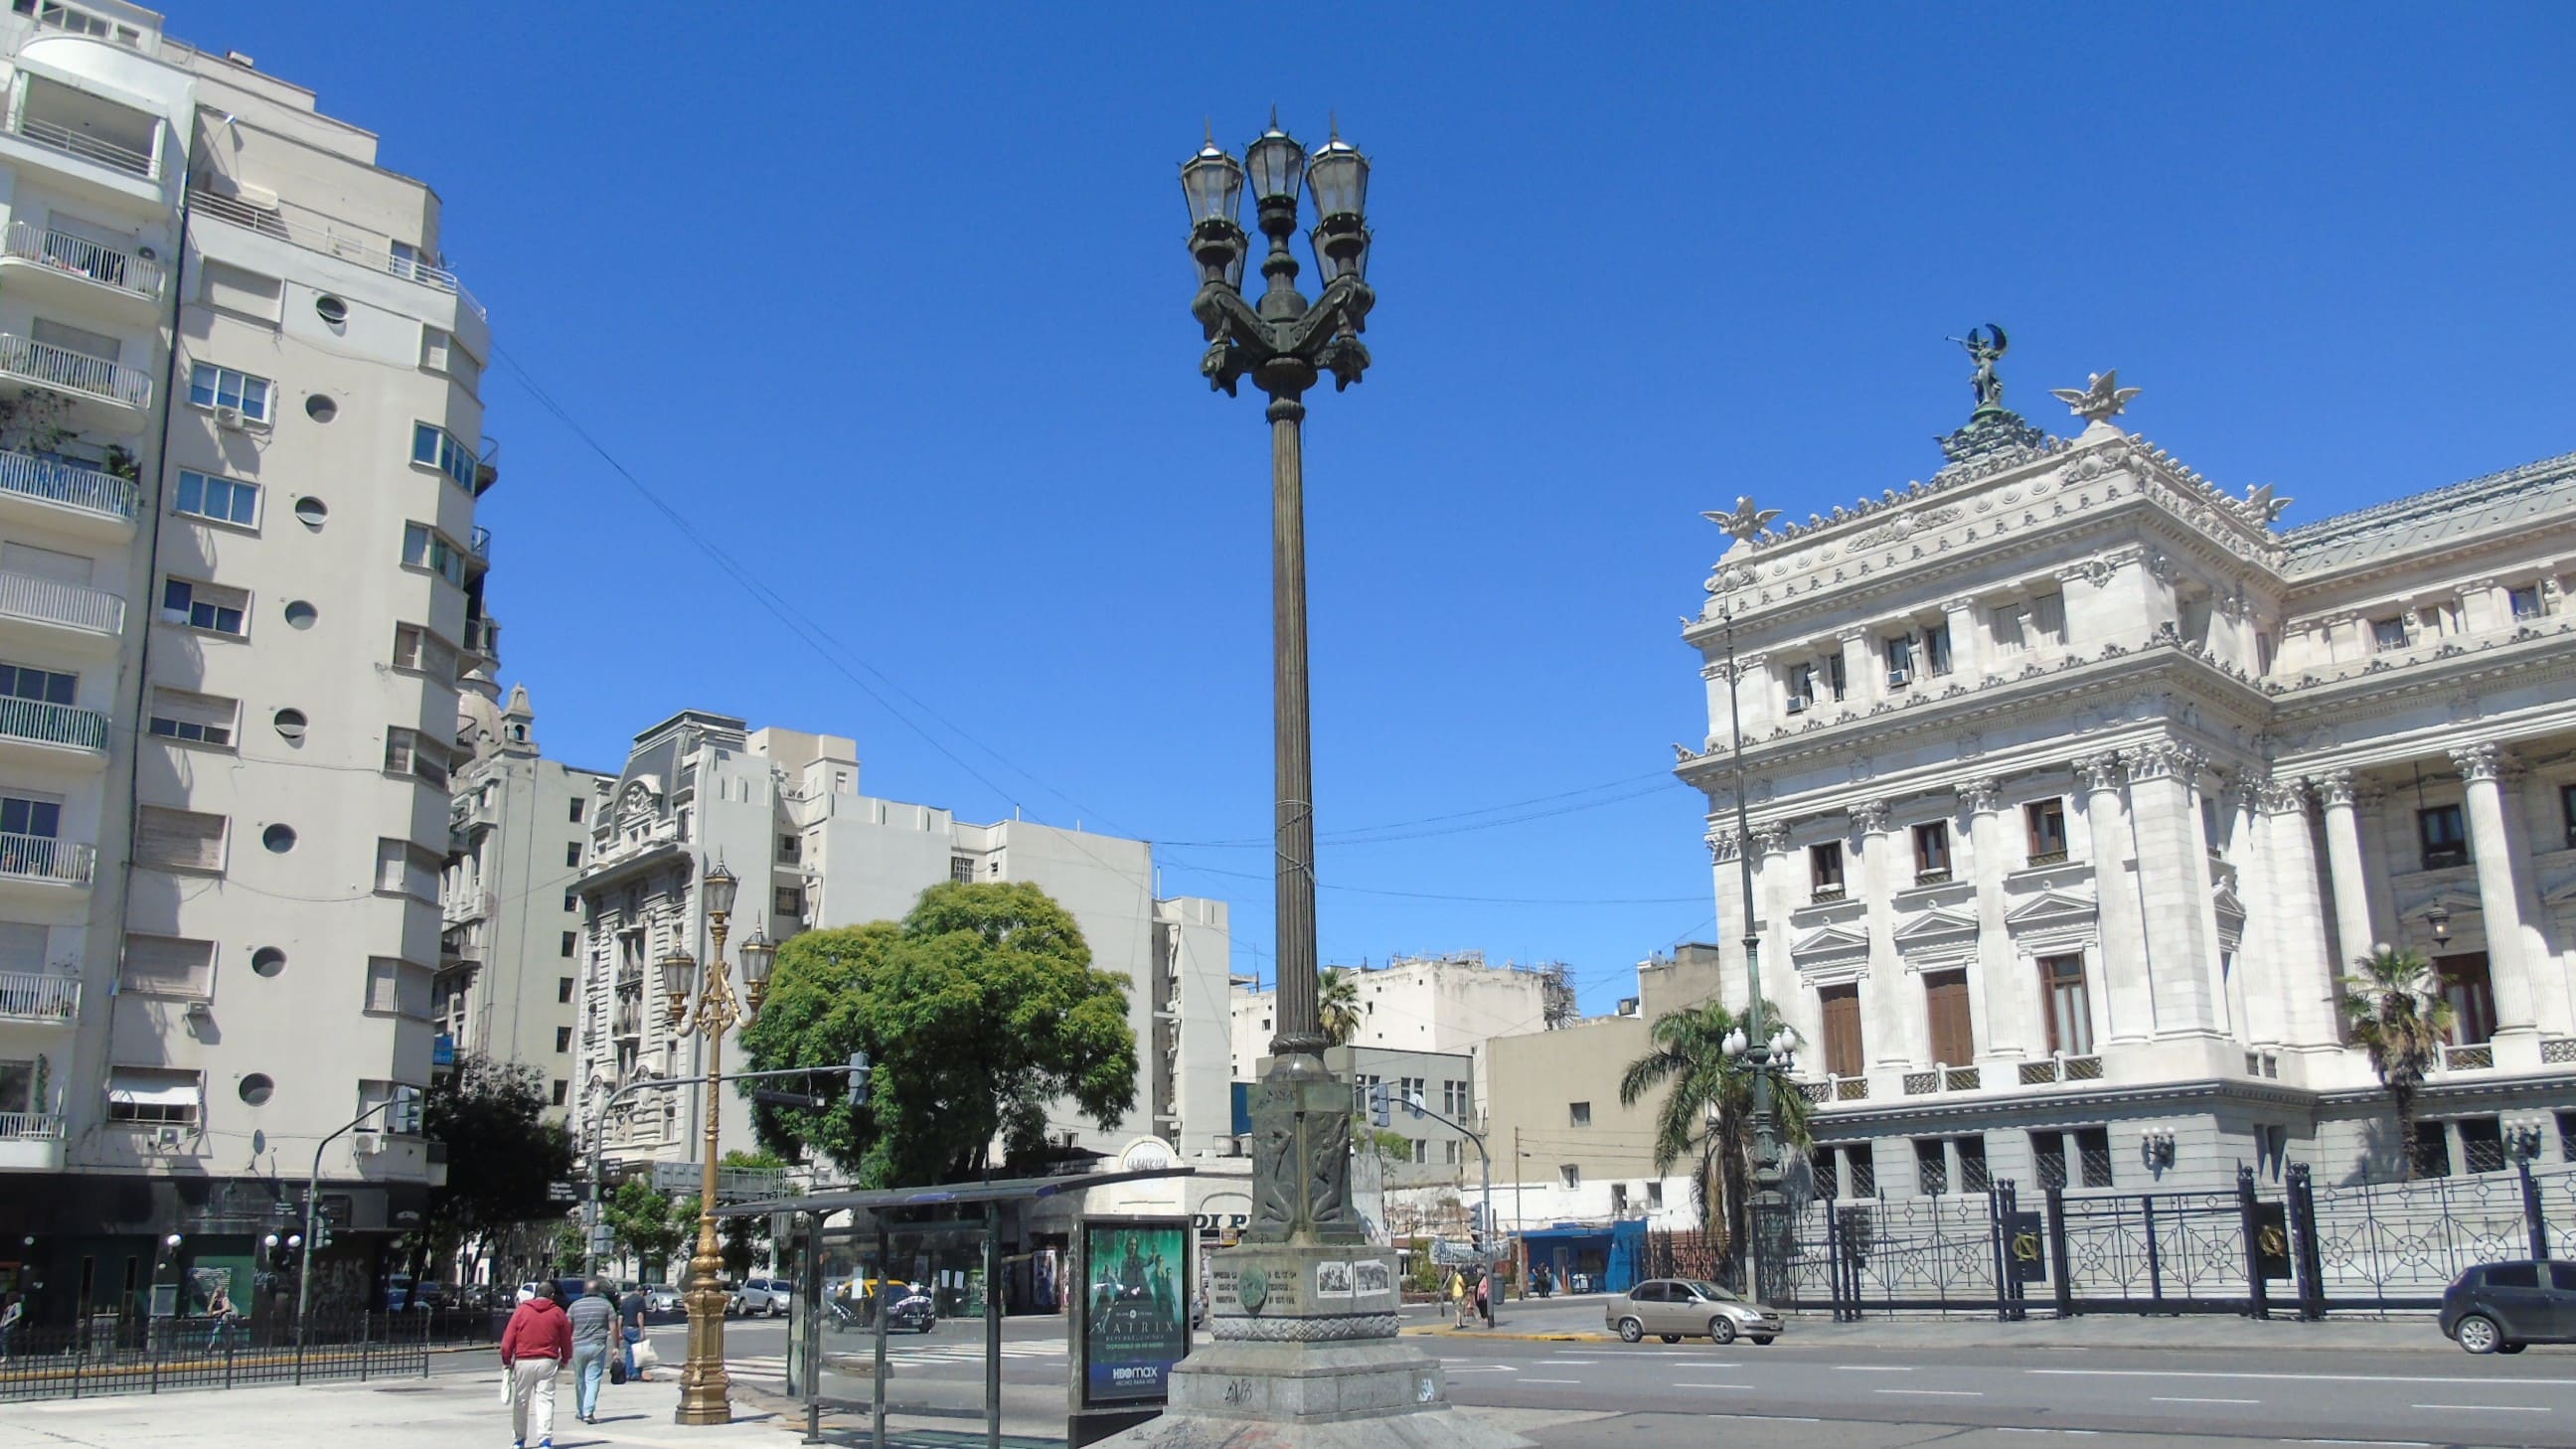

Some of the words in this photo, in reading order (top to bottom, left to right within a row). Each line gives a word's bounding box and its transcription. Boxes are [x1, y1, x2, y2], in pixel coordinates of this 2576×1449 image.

[1193, 1213, 1222, 1228] DI
[1227, 1213, 1252, 1228] P
[1096, 1321, 1174, 1334] MATRIX
